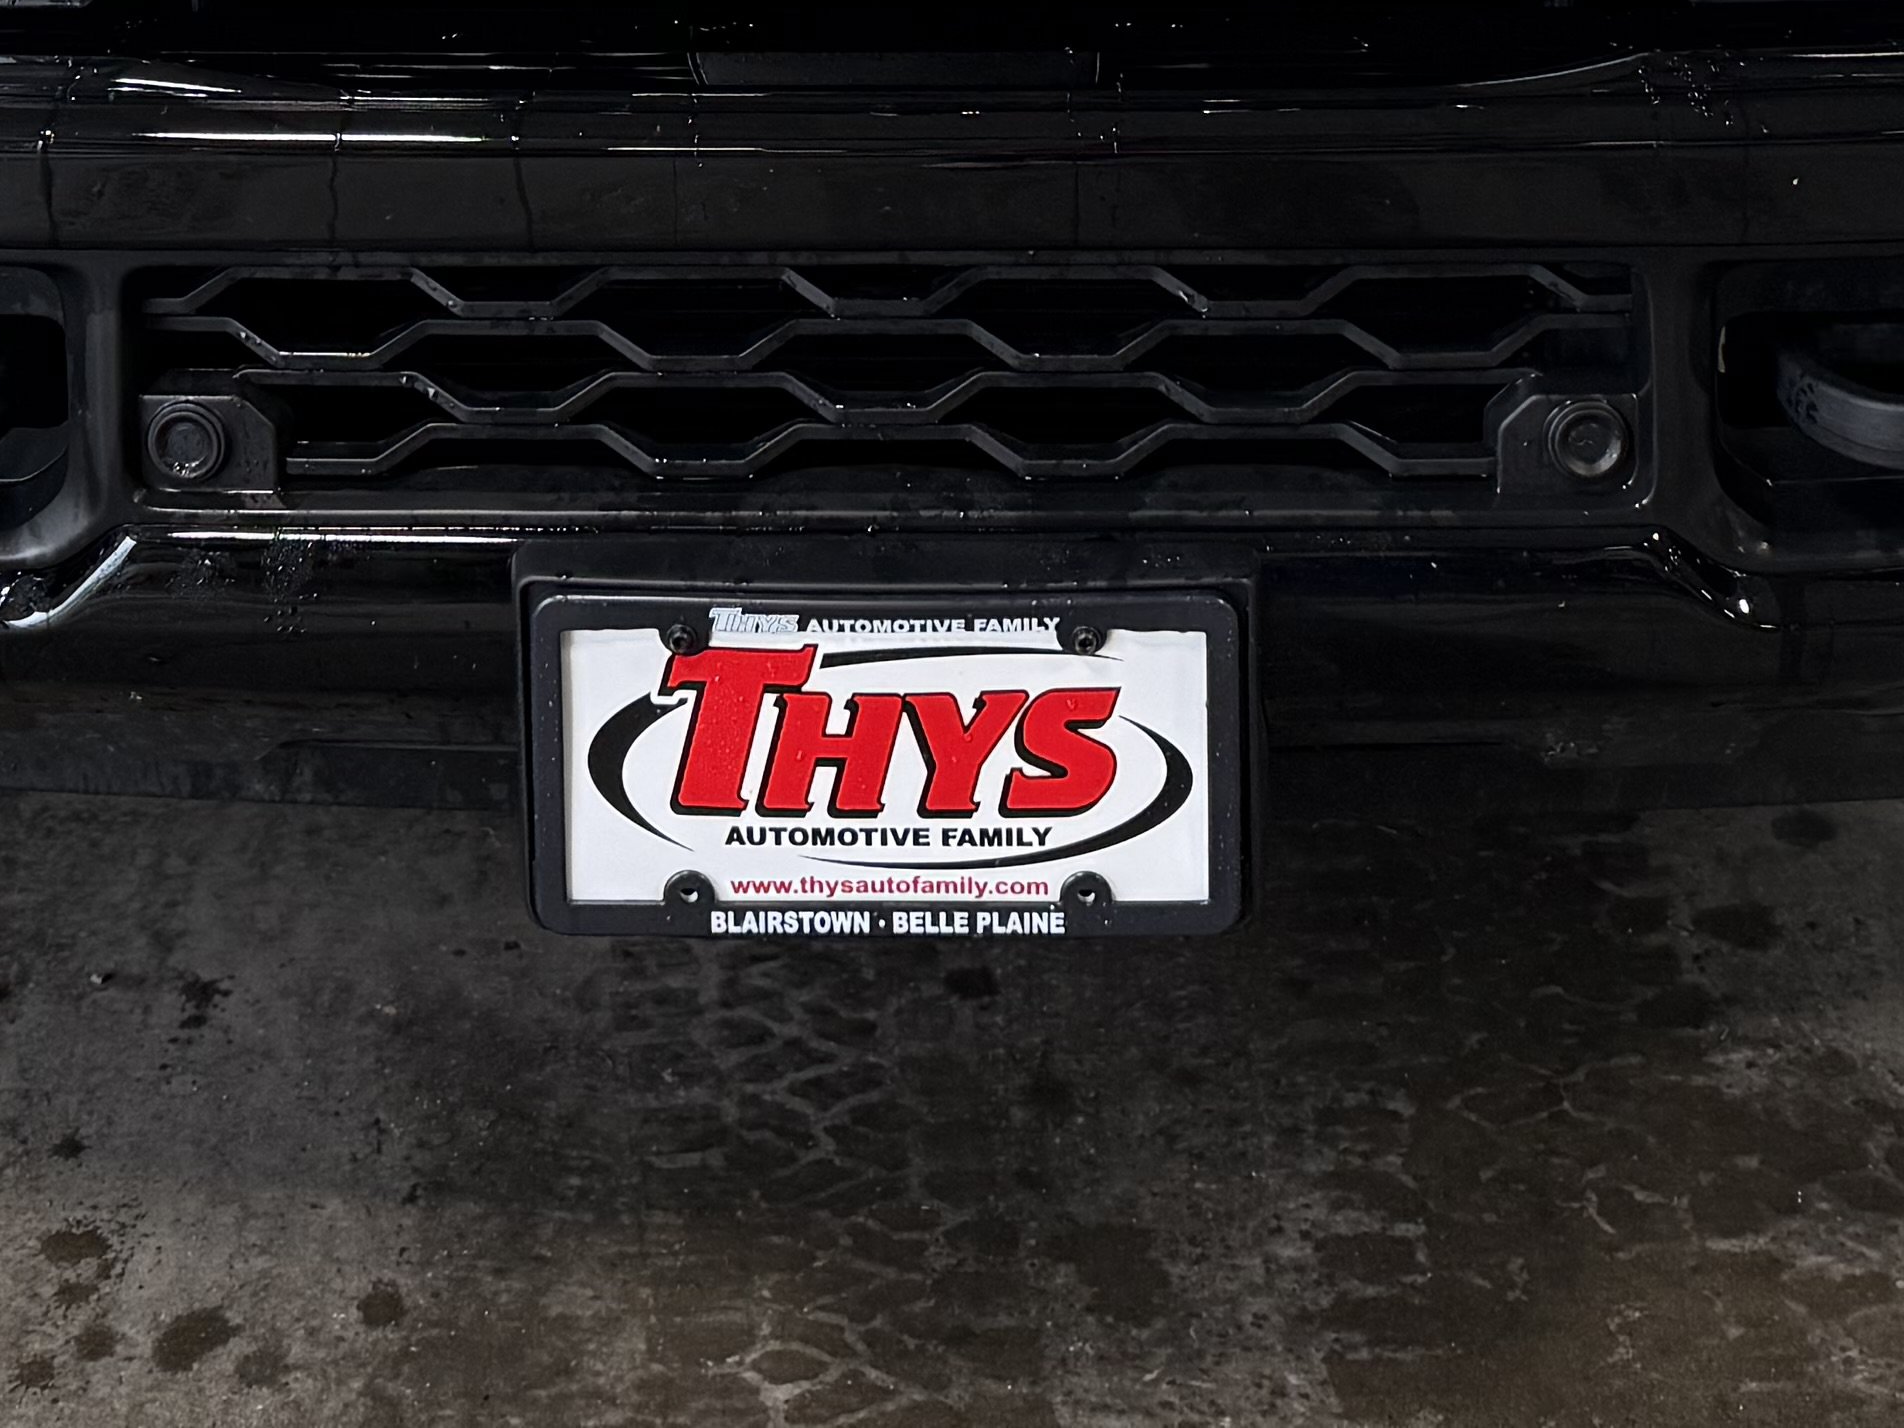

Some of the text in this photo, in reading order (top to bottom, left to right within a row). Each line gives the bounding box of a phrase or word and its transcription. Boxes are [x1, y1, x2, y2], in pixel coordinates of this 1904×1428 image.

[708, 607, 1061, 634] THYS AUTOMOTIVE FAMILY
[660, 645, 1122, 819] THYS
[724, 826, 1053, 848] AUTOMOTIVE FAMILY
[730, 875, 1050, 899] www.thysautofamily.com
[710, 911, 1066, 935] BLAIRSTOWN BELLE PLAINE
